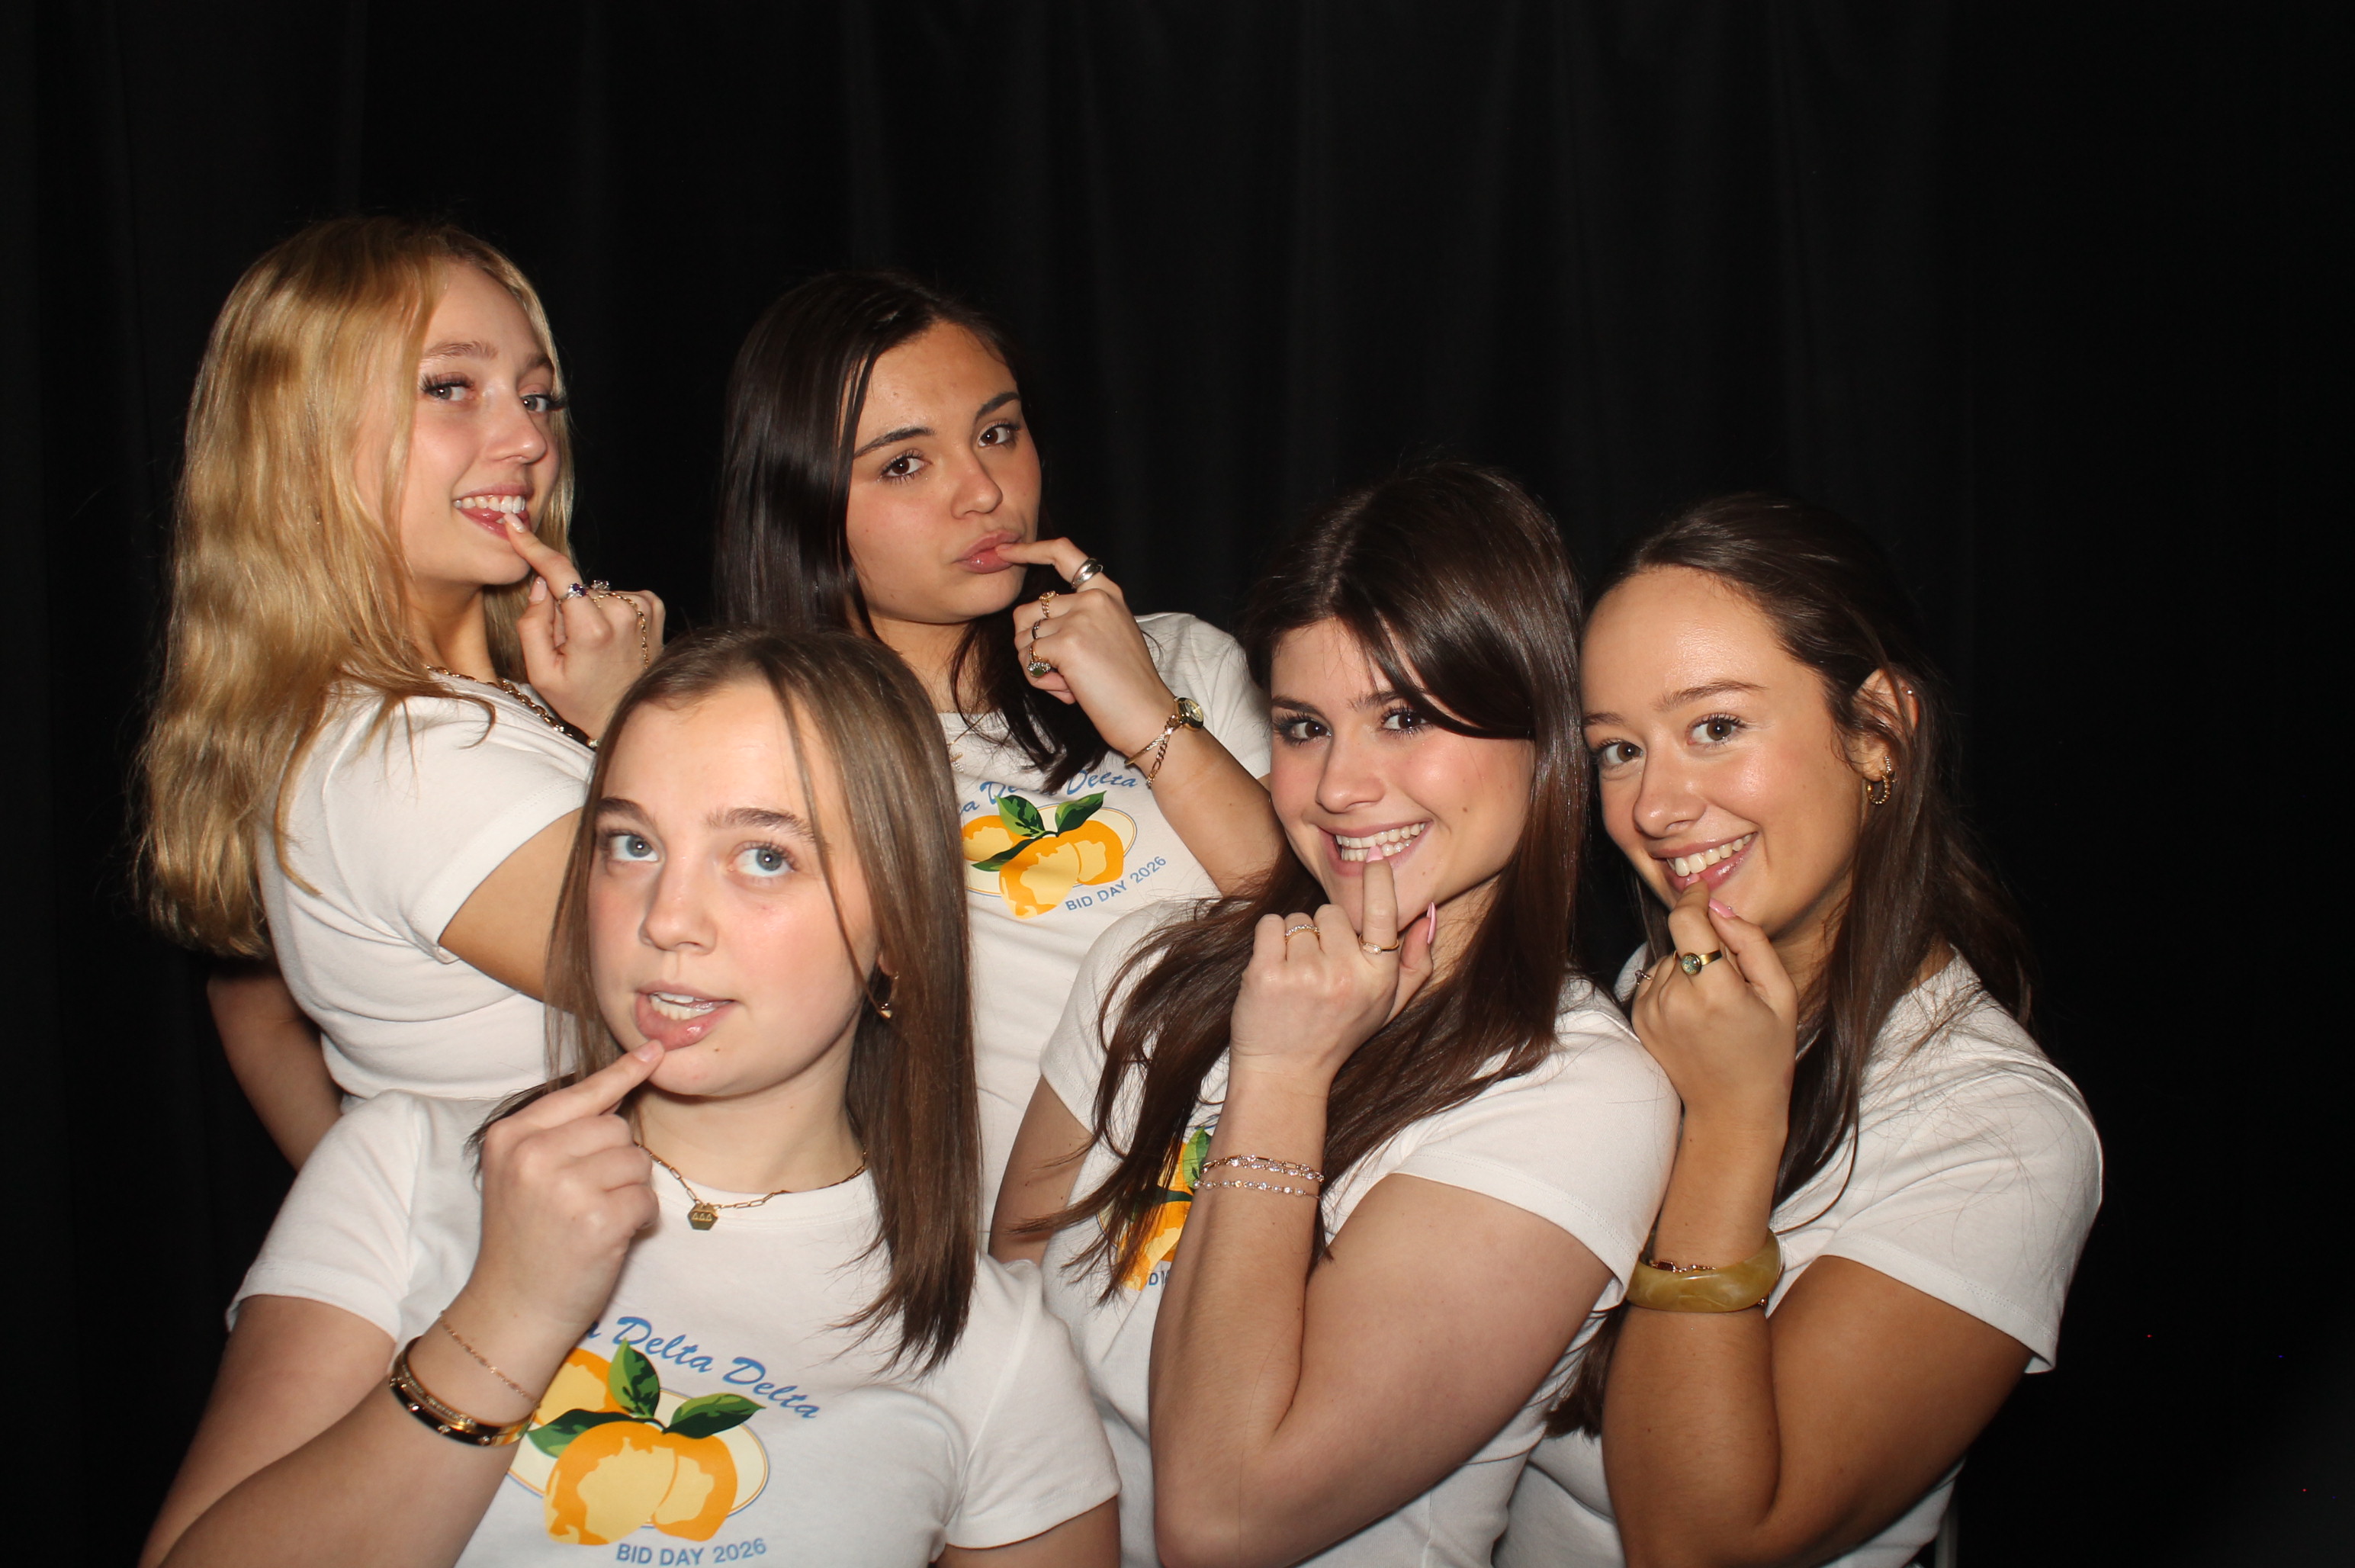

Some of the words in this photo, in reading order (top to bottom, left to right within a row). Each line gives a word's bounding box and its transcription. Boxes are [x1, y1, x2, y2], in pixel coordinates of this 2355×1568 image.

[1065, 895, 1094, 911] BID
[1097, 879, 1127, 903] DAY
[1129, 856, 1167, 884] 2026
[612, 1316, 714, 1373] Delta
[722, 1357, 821, 1419] Delta
[615, 1543, 652, 1565] BID
[659, 1547, 705, 1567] DAY
[712, 1537, 767, 1564] 2026
